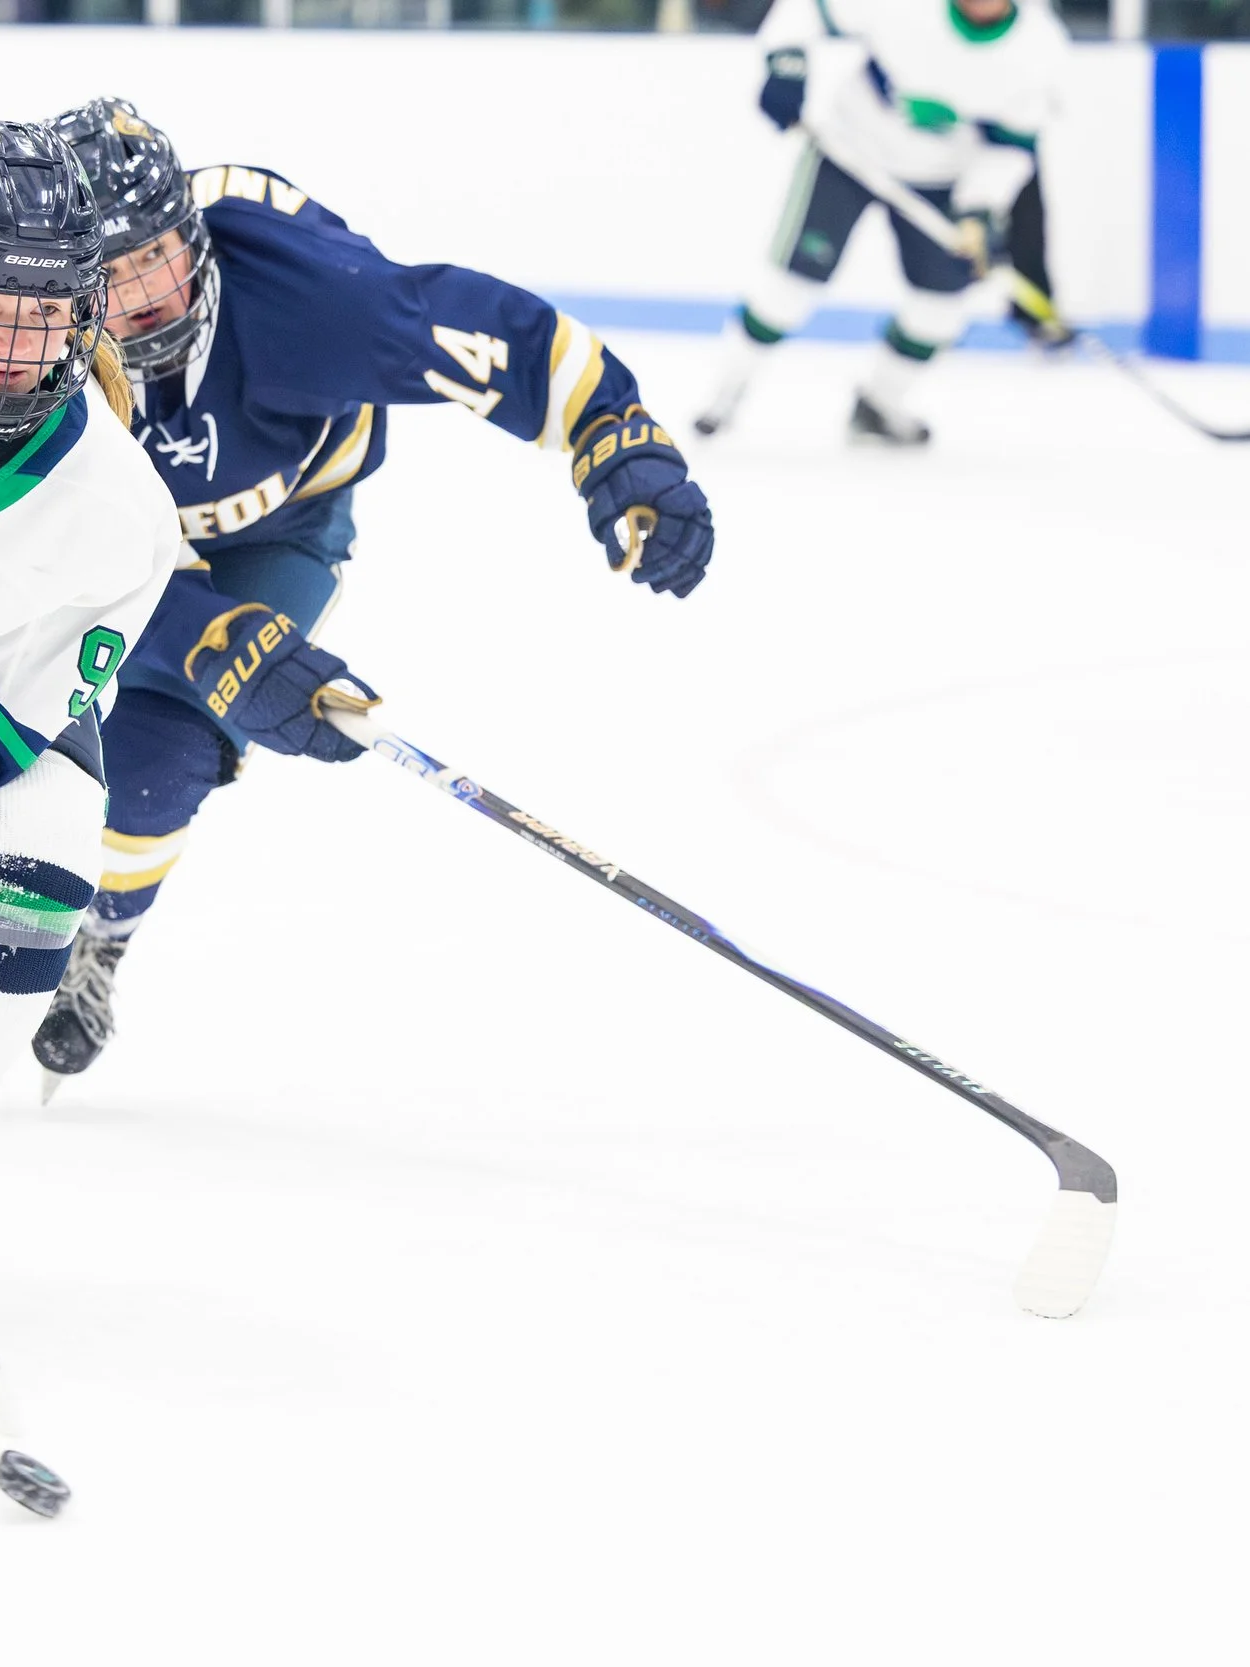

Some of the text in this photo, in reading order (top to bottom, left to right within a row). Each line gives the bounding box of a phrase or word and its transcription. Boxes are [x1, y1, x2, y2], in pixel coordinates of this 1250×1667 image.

[4, 254, 67, 269] BAUER
[102, 213, 131, 237] OLK
[423, 324, 508, 419] 14
[573, 423, 674, 489] BAUE
[69, 625, 126, 719] 9
[206, 613, 298, 718] BAUER
